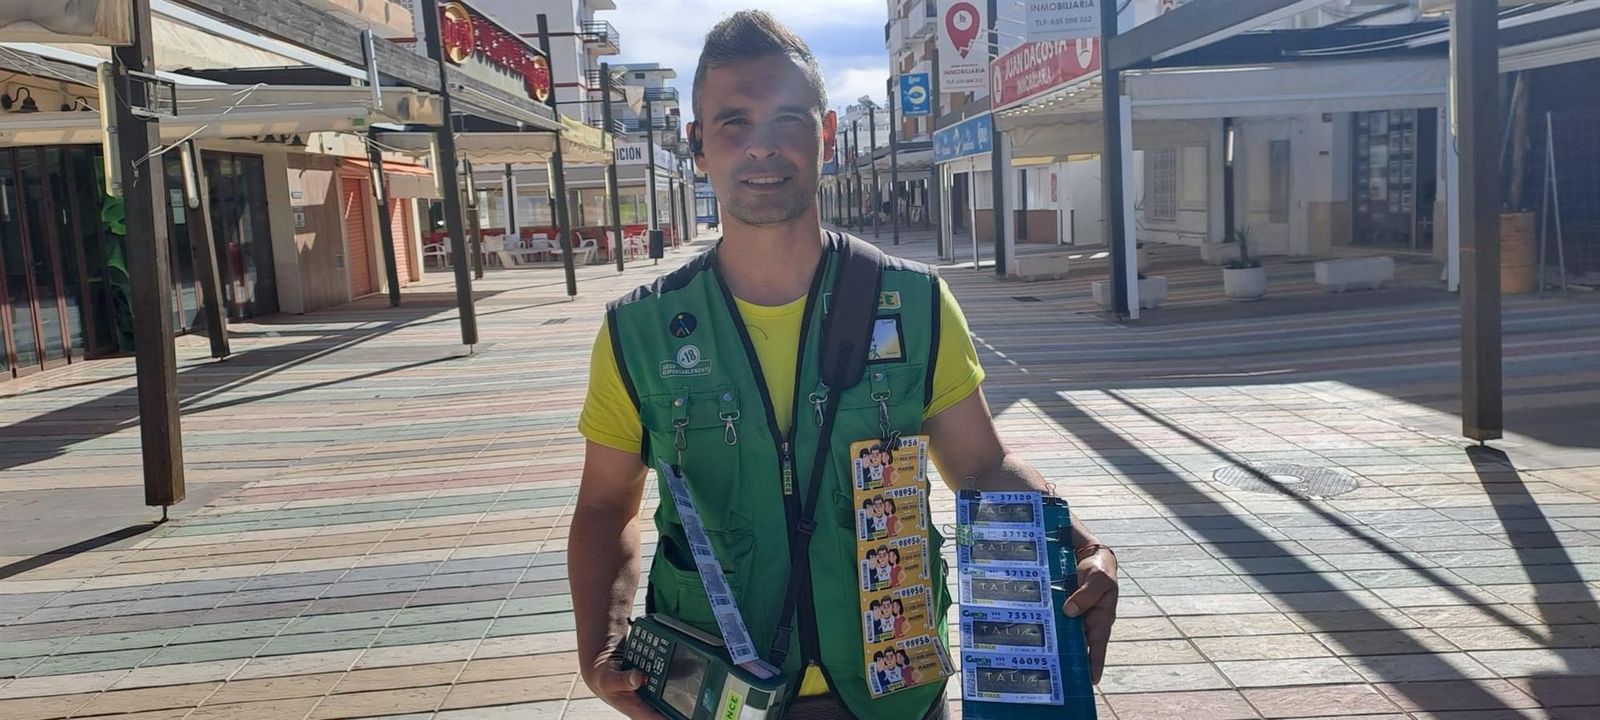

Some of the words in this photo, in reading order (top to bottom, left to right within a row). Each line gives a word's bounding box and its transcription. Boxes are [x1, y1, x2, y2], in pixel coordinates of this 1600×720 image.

[1005, 51, 1023, 80] JUAN
[784, 470, 792, 493] ONCE
[894, 488, 917, 498] 98956
[1005, 570, 1039, 578] 37120
[1008, 612, 1042, 620] 73512
[1012, 657, 1048, 666] 46095
